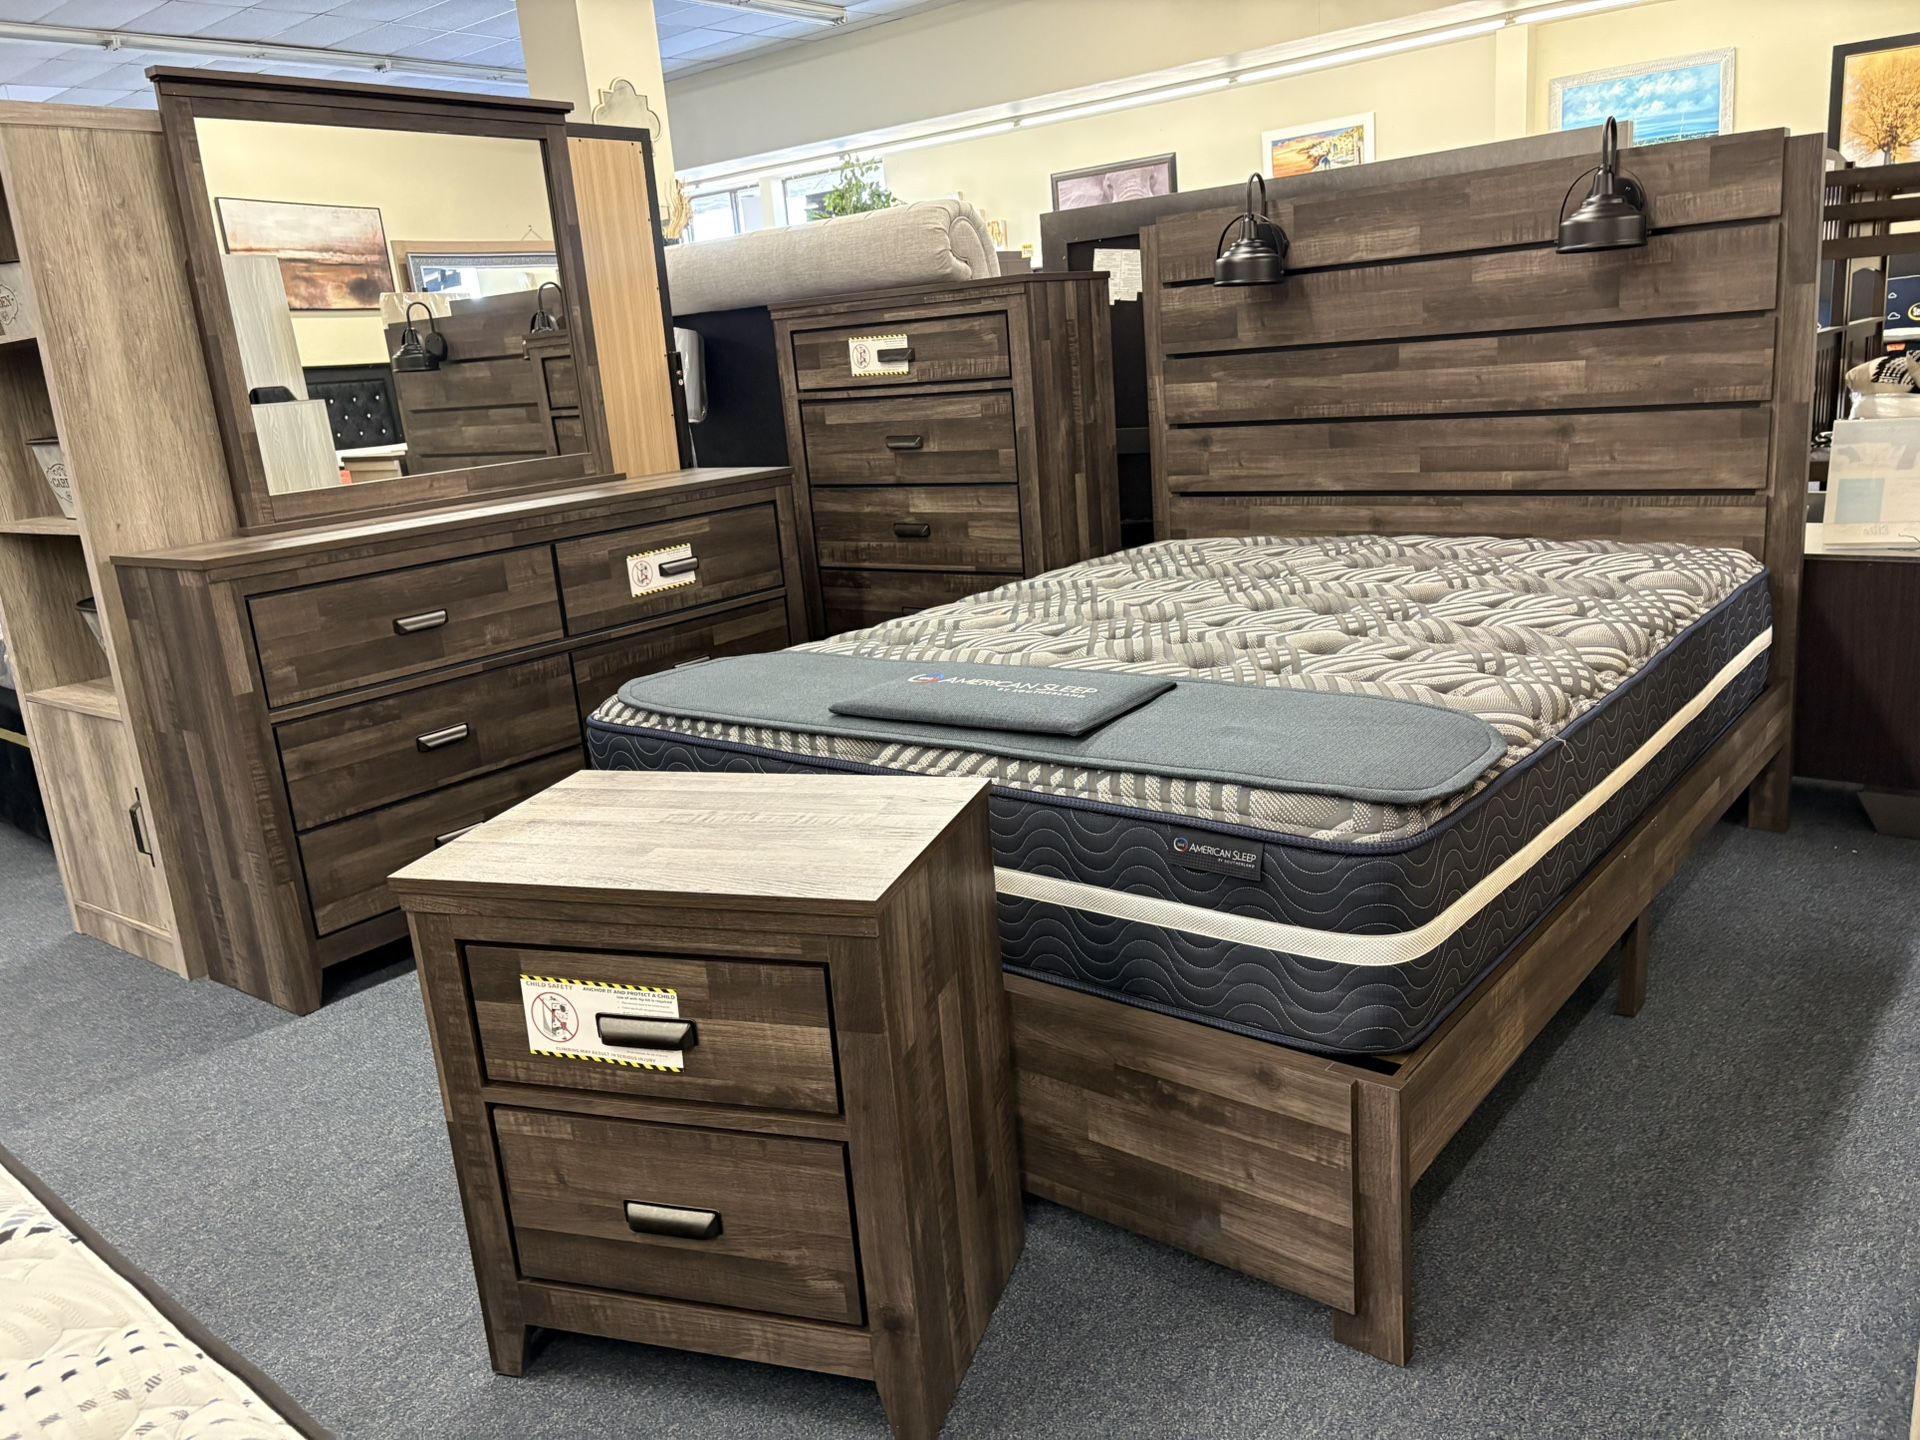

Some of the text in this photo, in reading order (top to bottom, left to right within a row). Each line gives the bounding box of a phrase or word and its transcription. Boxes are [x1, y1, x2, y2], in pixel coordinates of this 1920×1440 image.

[939, 676, 1099, 695] AMERICAN SLEEP
[1189, 843, 1231, 858] AMERICAN
[1233, 851, 1256, 862] SLEEP
[525, 980, 573, 990] CHILD SAFETY
[617, 1053, 638, 1061] SERIOUS
